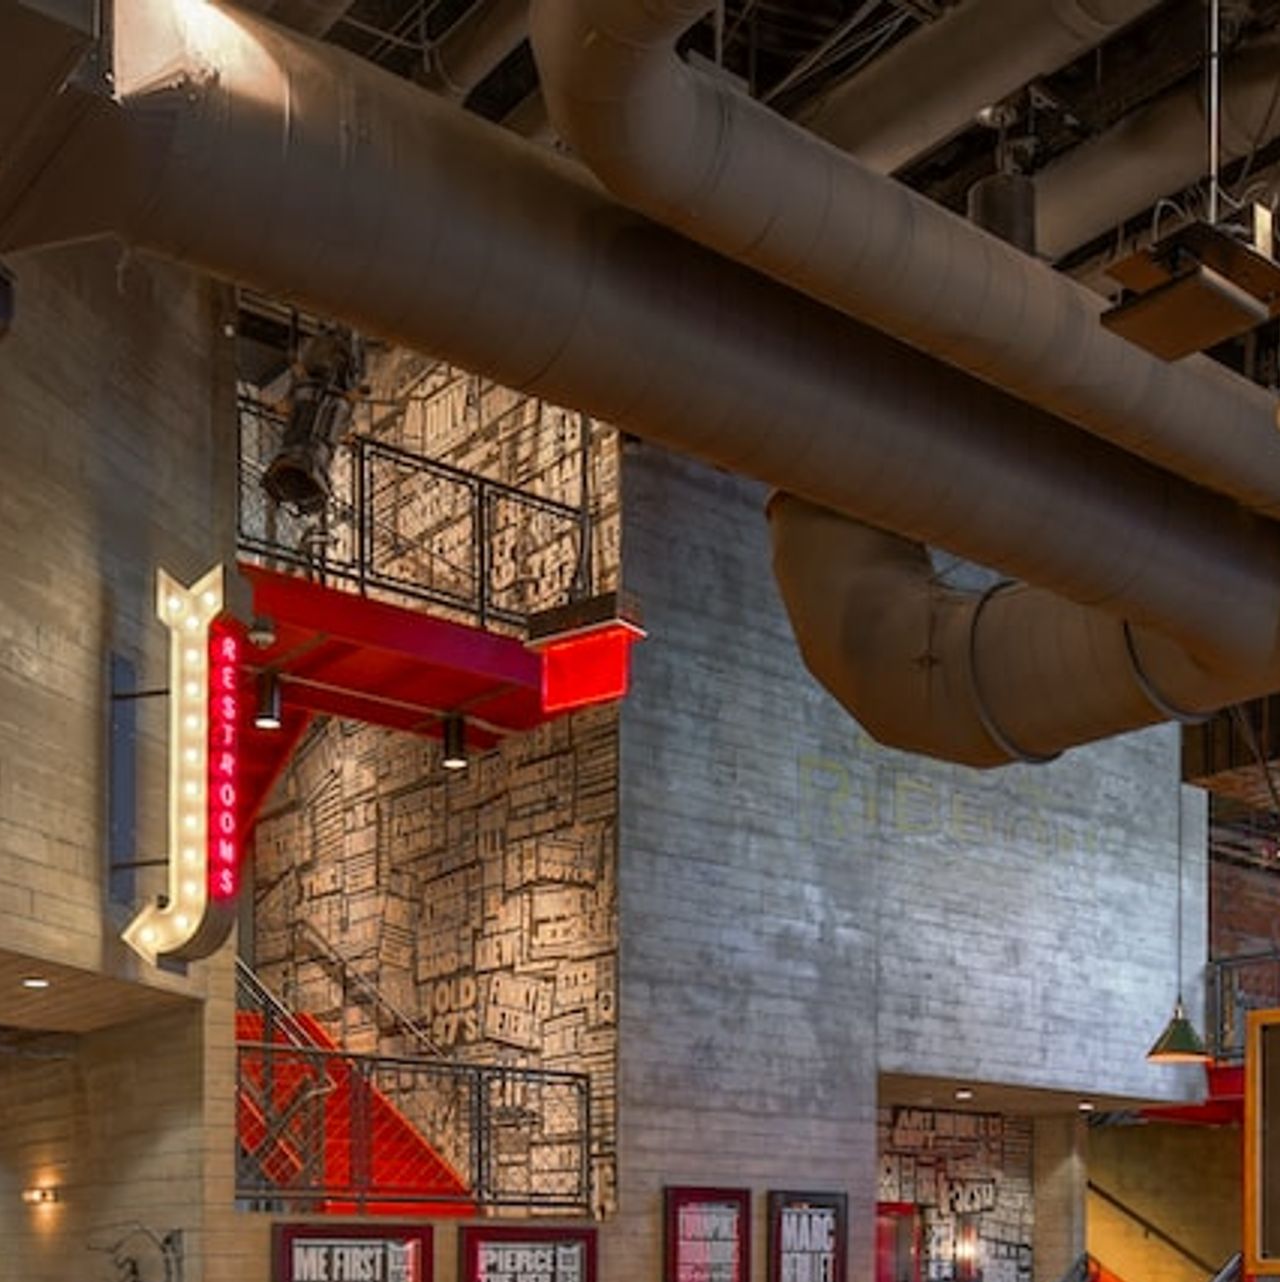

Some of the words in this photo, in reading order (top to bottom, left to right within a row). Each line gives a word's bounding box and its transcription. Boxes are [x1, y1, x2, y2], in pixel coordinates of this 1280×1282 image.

[219, 636, 237, 895] RESTROOMS
[435, 976, 476, 1012] OLD
[782, 1213, 834, 1250] MARC
[295, 1246, 330, 1281] ME
[333, 1246, 382, 1281] FIRST
[479, 1250, 554, 1272] PIERCE
